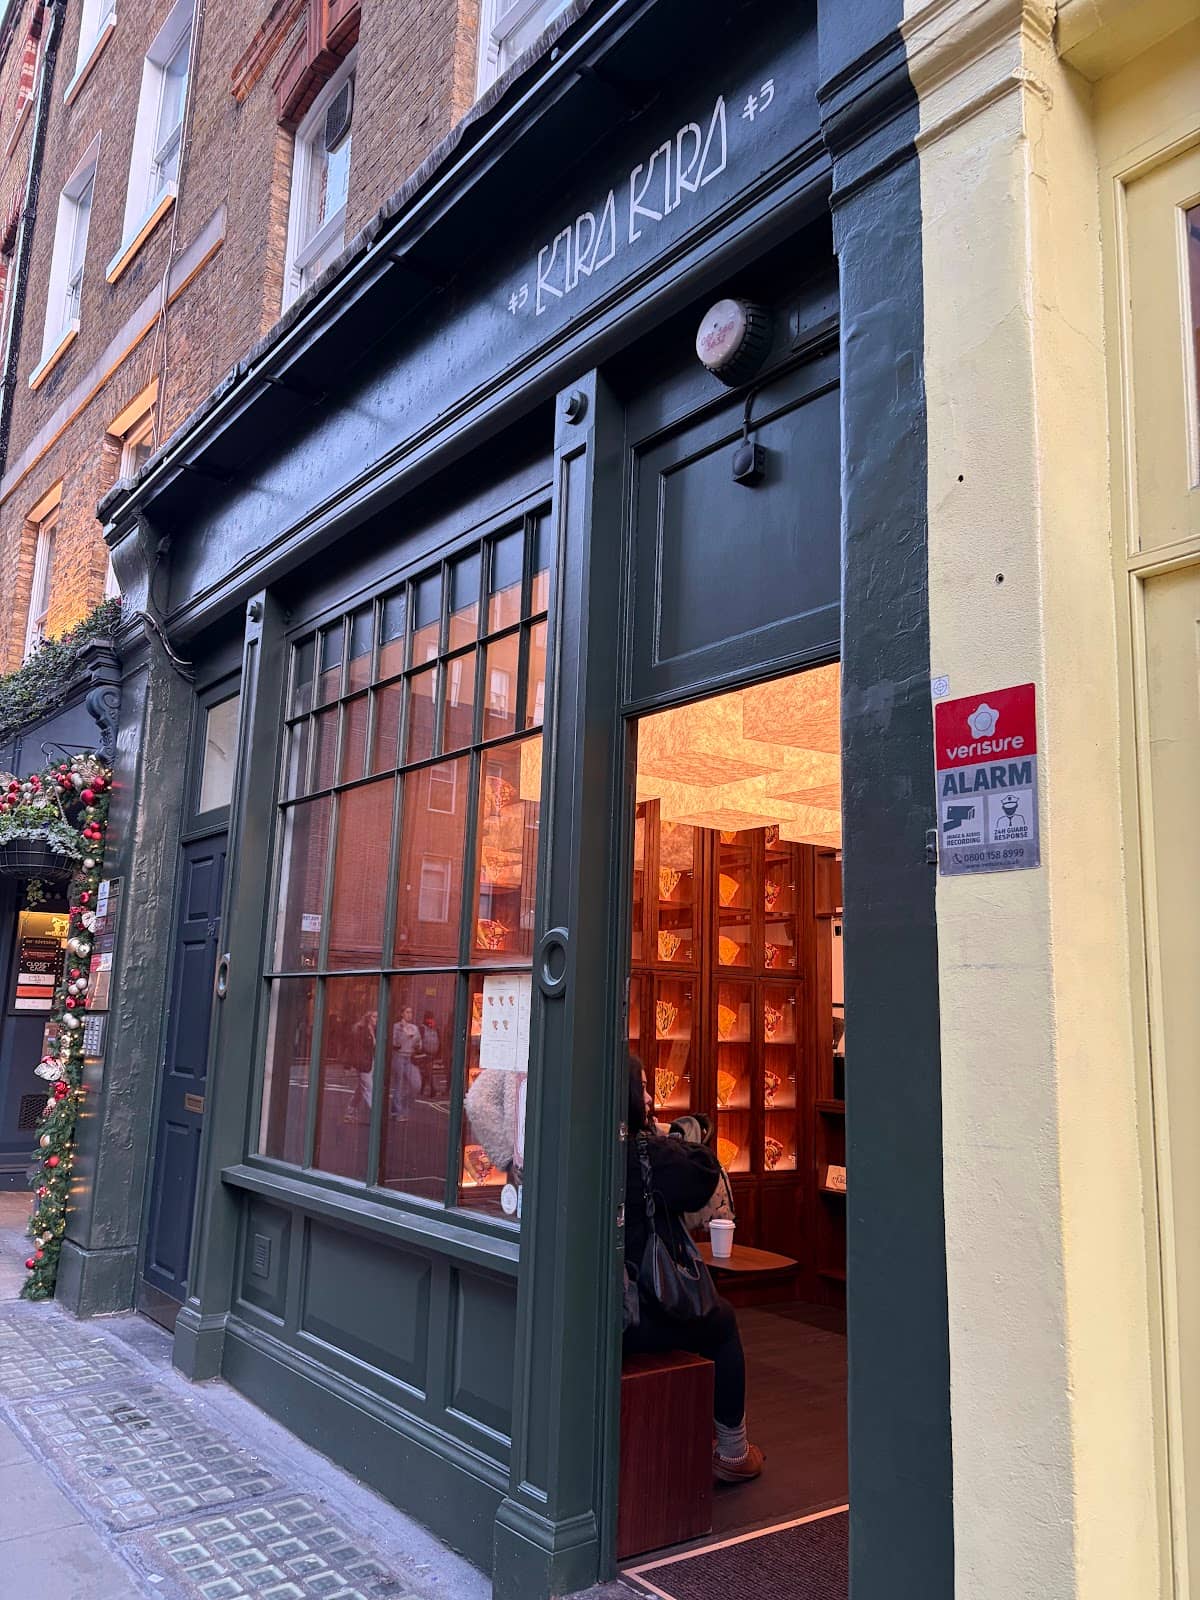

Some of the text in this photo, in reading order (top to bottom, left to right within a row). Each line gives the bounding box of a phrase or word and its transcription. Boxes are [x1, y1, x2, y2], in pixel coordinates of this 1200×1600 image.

[508, 79, 774, 316] キラ KIRA KIRA キラ
[946, 736, 1025, 760] verisure
[943, 761, 1032, 796] ALARM
[947, 837, 981, 846] RECORDING
[994, 832, 1028, 840] RESPONSE
[964, 848, 1024, 862] 0800 158 8999
